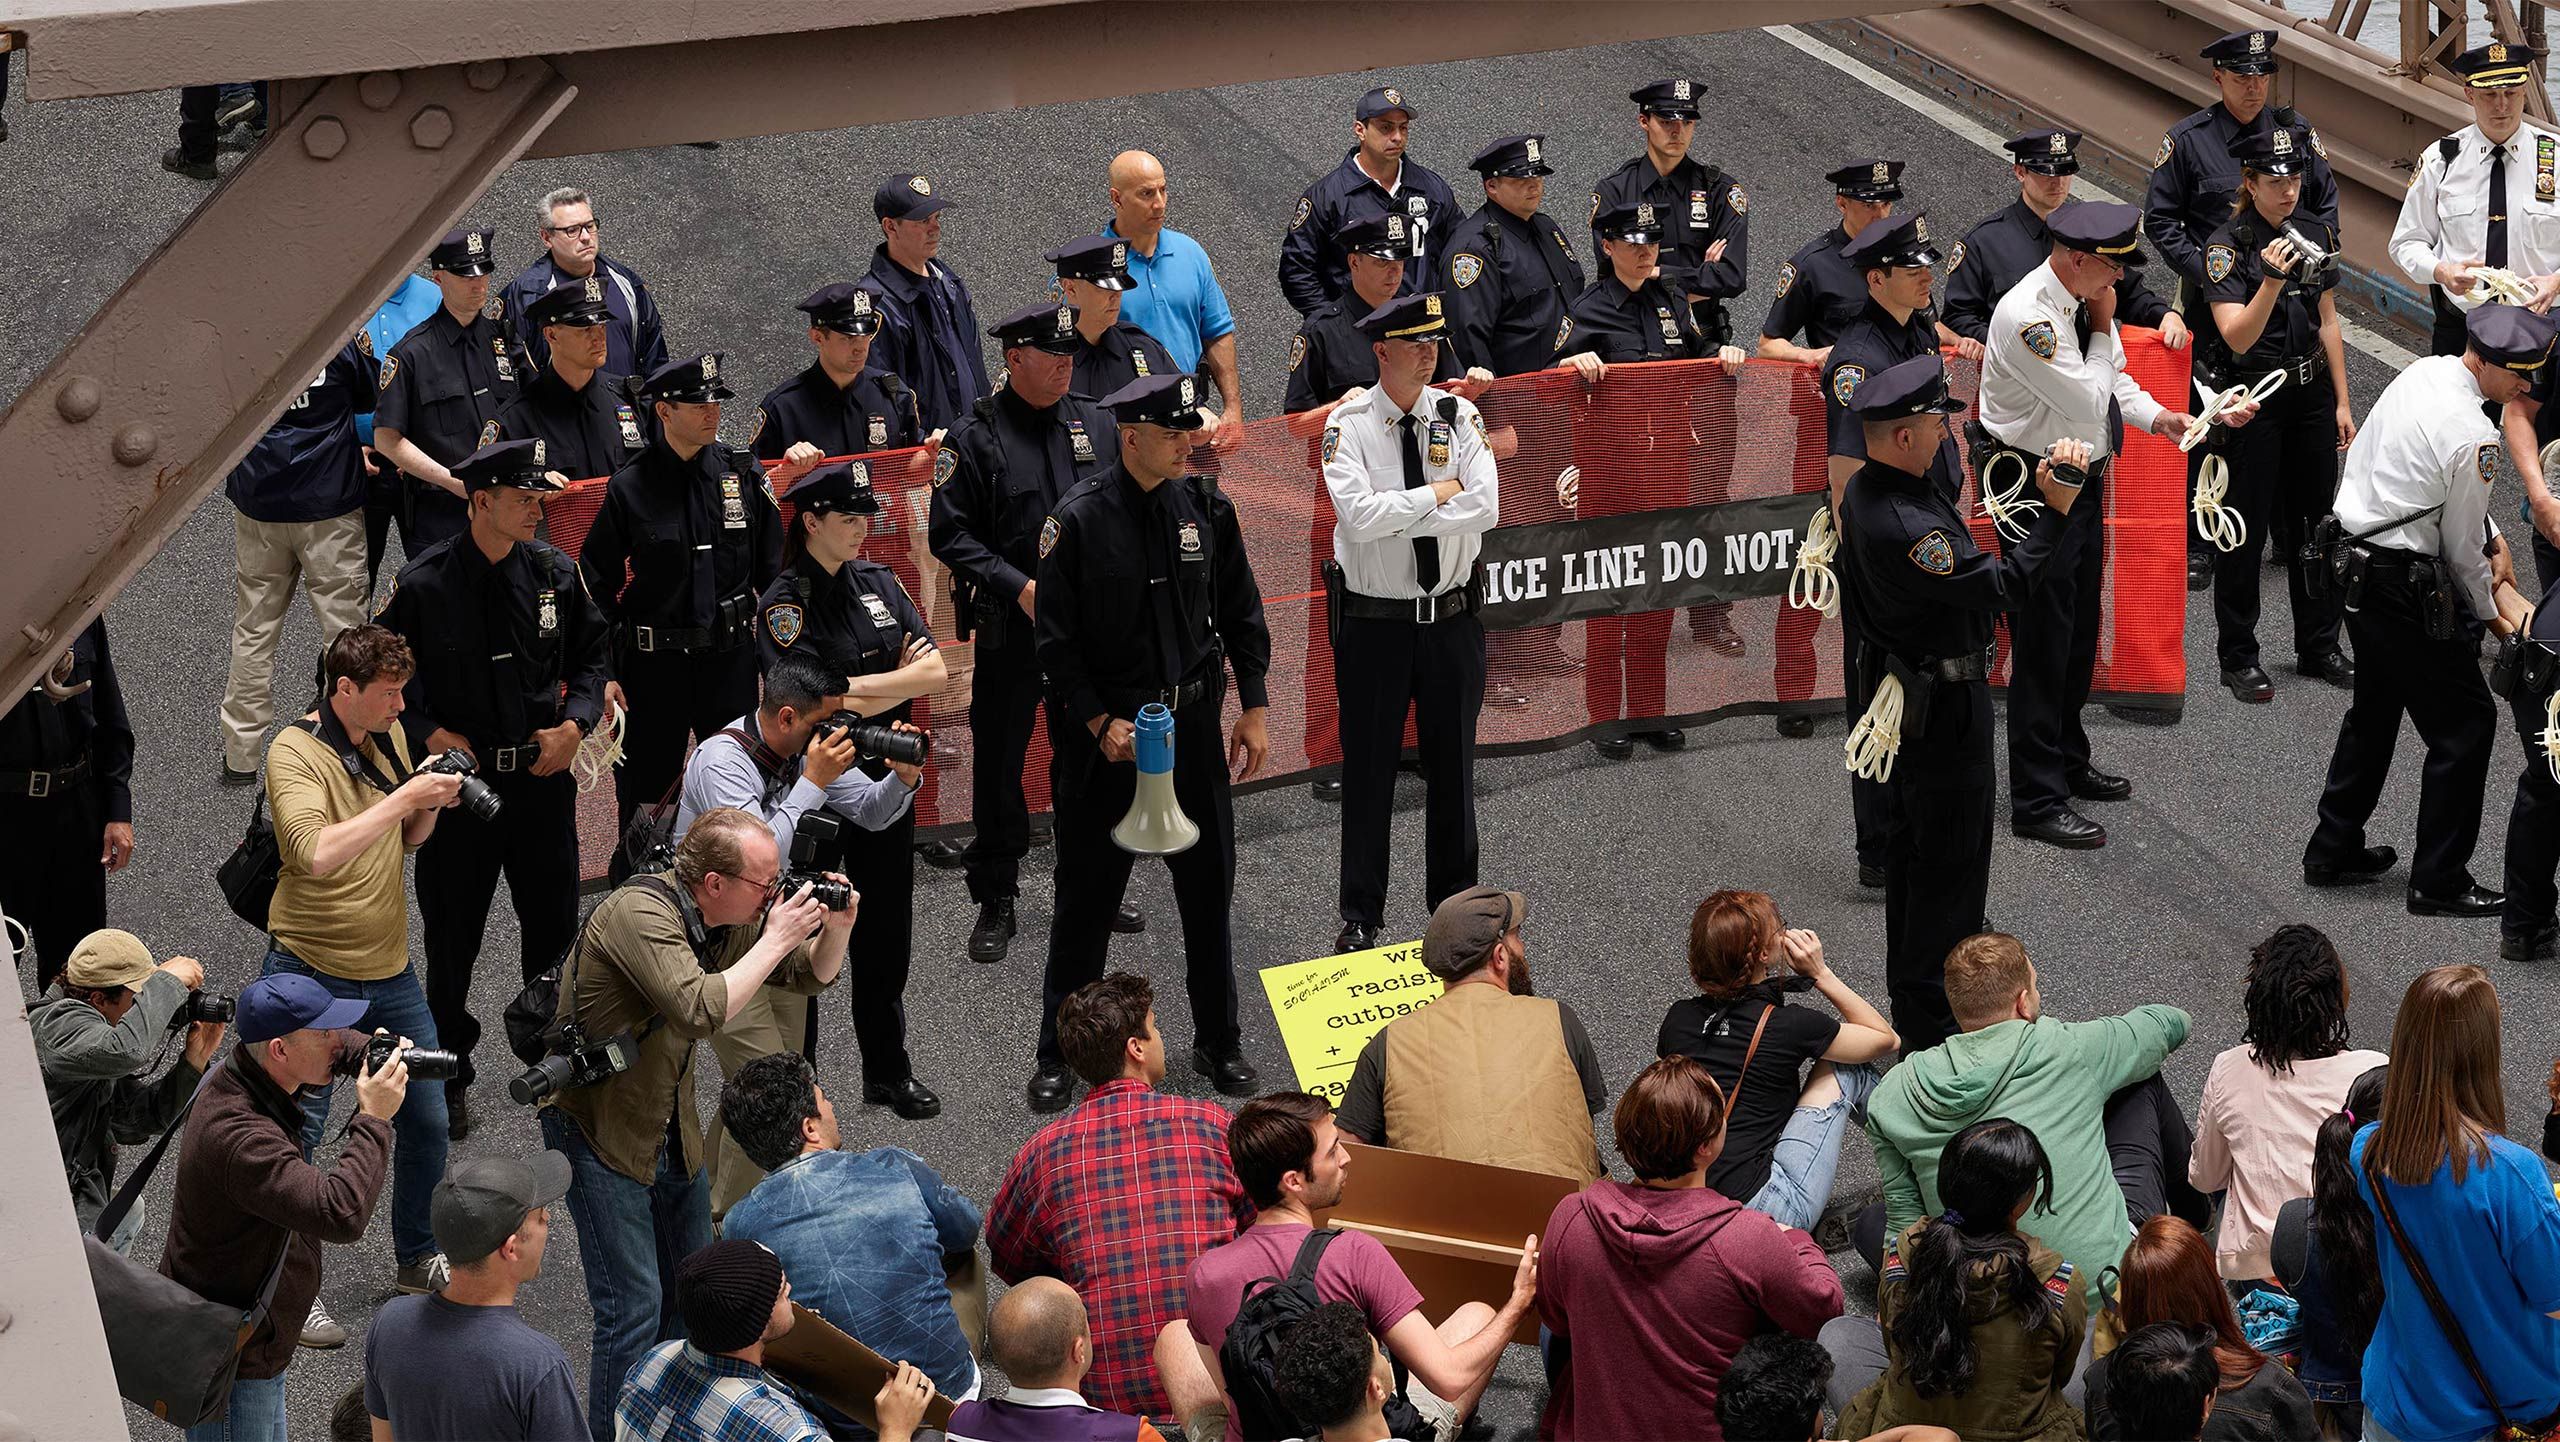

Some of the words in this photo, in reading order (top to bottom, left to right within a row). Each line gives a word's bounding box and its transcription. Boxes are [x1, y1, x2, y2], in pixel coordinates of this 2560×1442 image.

[1483, 557, 1547, 604] ICE
[1561, 544, 1646, 594] LINE
[1660, 537, 1708, 583] DO
[1724, 528, 1794, 576] NOT
[1383, 947, 1423, 963] wa
[1283, 967, 1350, 1010] SOCIALISM
[1286, 979, 1305, 992] time
[1306, 972, 1318, 983] for
[1327, 994, 1437, 1029] cutbac
[1309, 1080, 1352, 1098] ca
